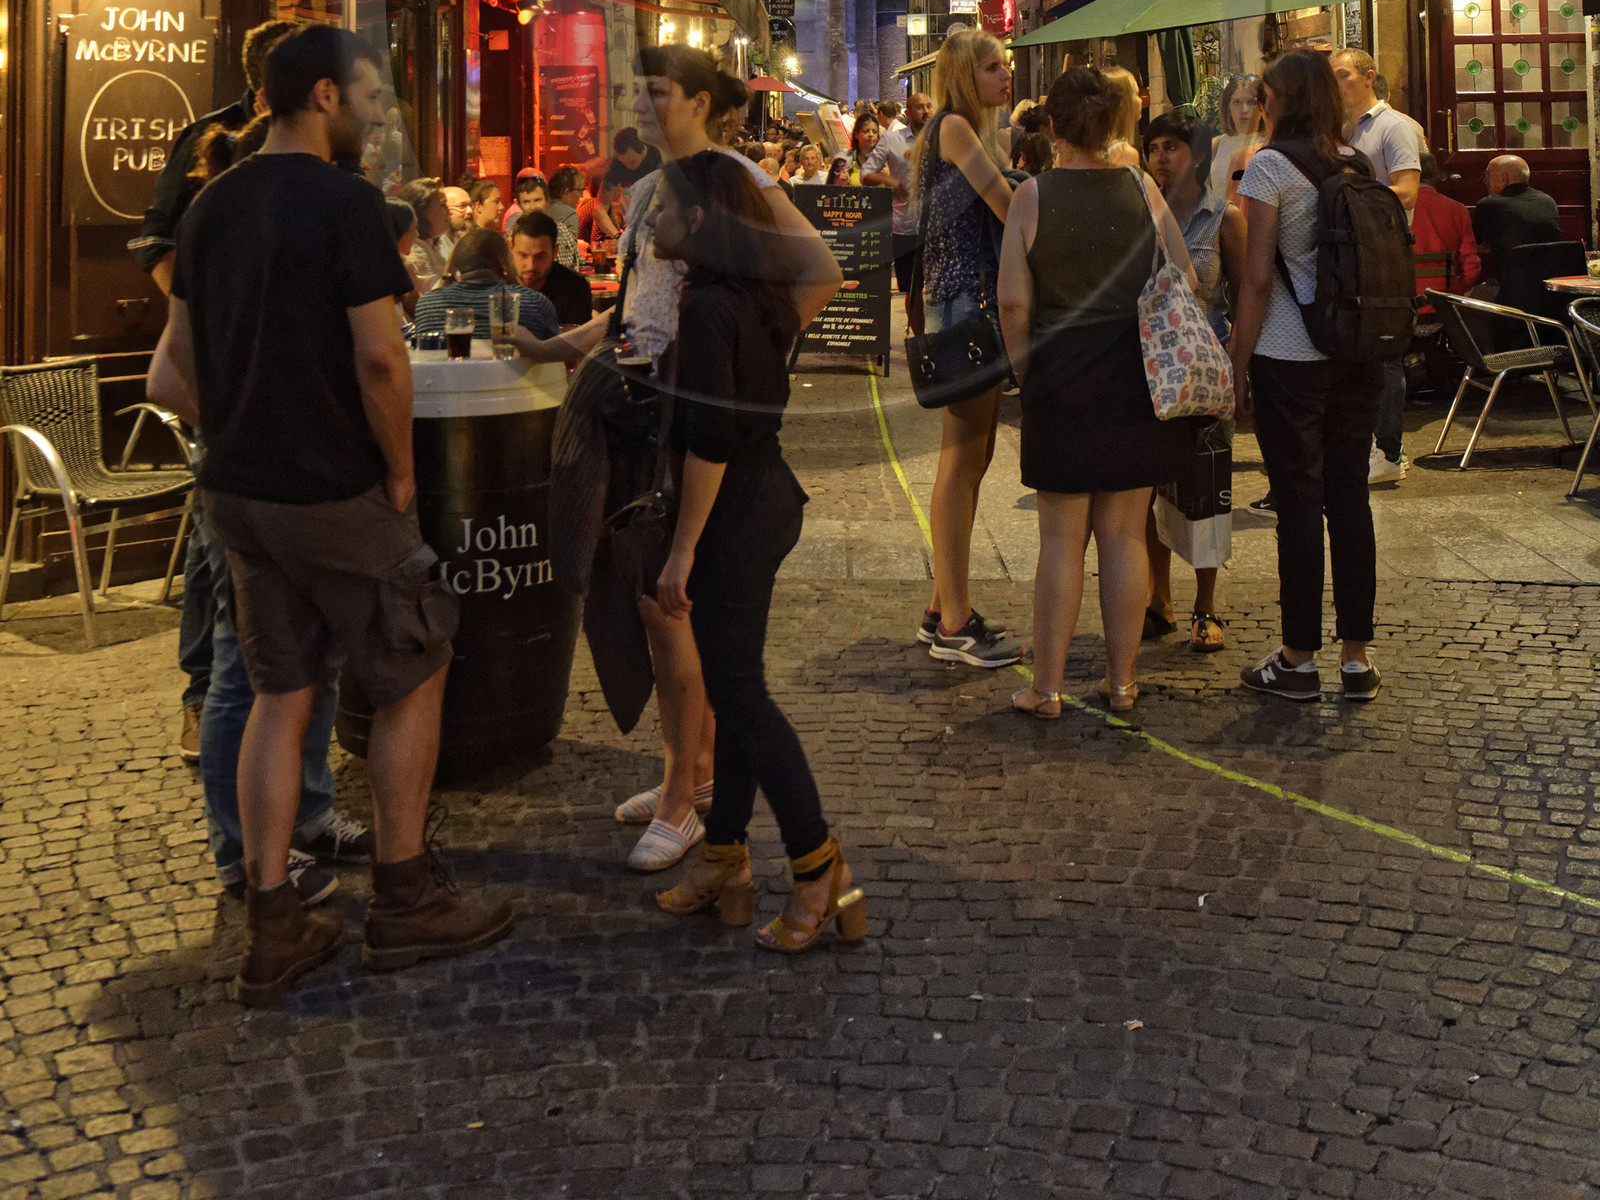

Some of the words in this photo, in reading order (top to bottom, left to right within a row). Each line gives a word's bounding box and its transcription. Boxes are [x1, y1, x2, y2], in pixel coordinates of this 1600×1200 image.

[101, 7, 185, 32] JOHN
[93, 117, 192, 141] IRISH
[113, 147, 166, 171] PUB
[823, 210, 843, 218] HAPPY
[845, 211, 863, 219] HOUR
[456, 514, 539, 554] John
